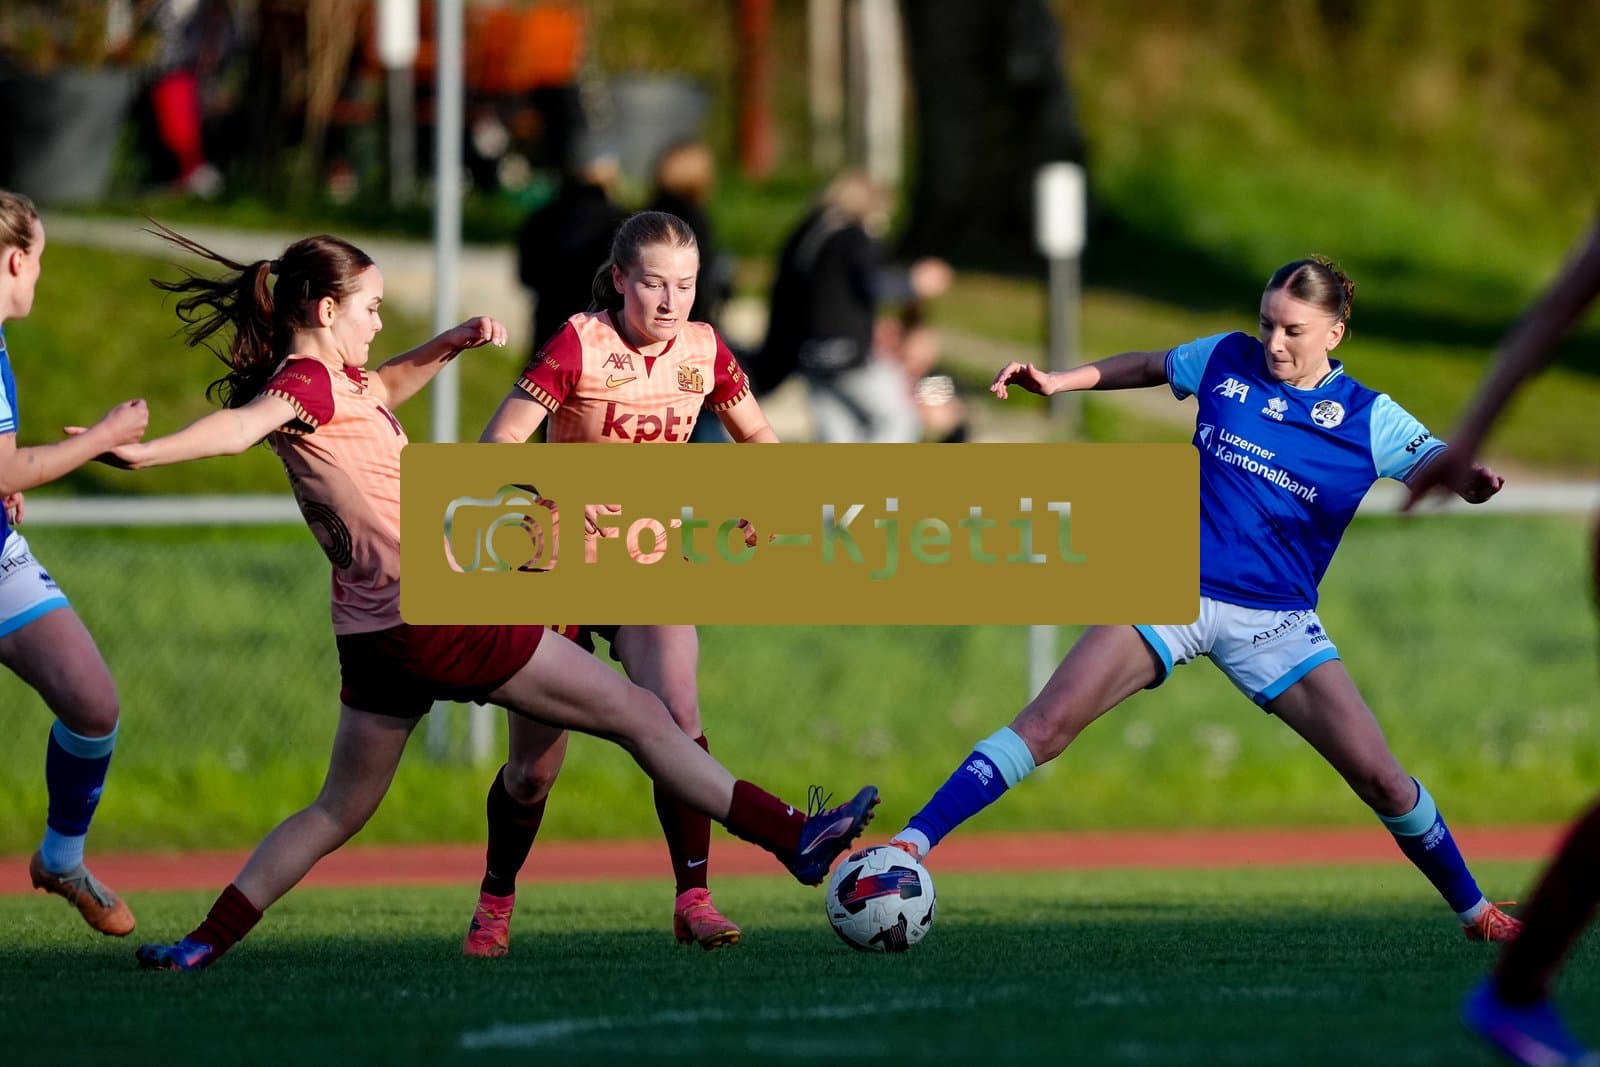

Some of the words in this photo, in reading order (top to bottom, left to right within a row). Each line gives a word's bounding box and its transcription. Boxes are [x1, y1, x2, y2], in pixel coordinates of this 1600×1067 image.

[602, 352, 634, 371] AXA
[1212, 378, 1250, 403] AXA
[1219, 428, 1276, 461] Luzerner
[1215, 443, 1318, 504] Kantonalbank
